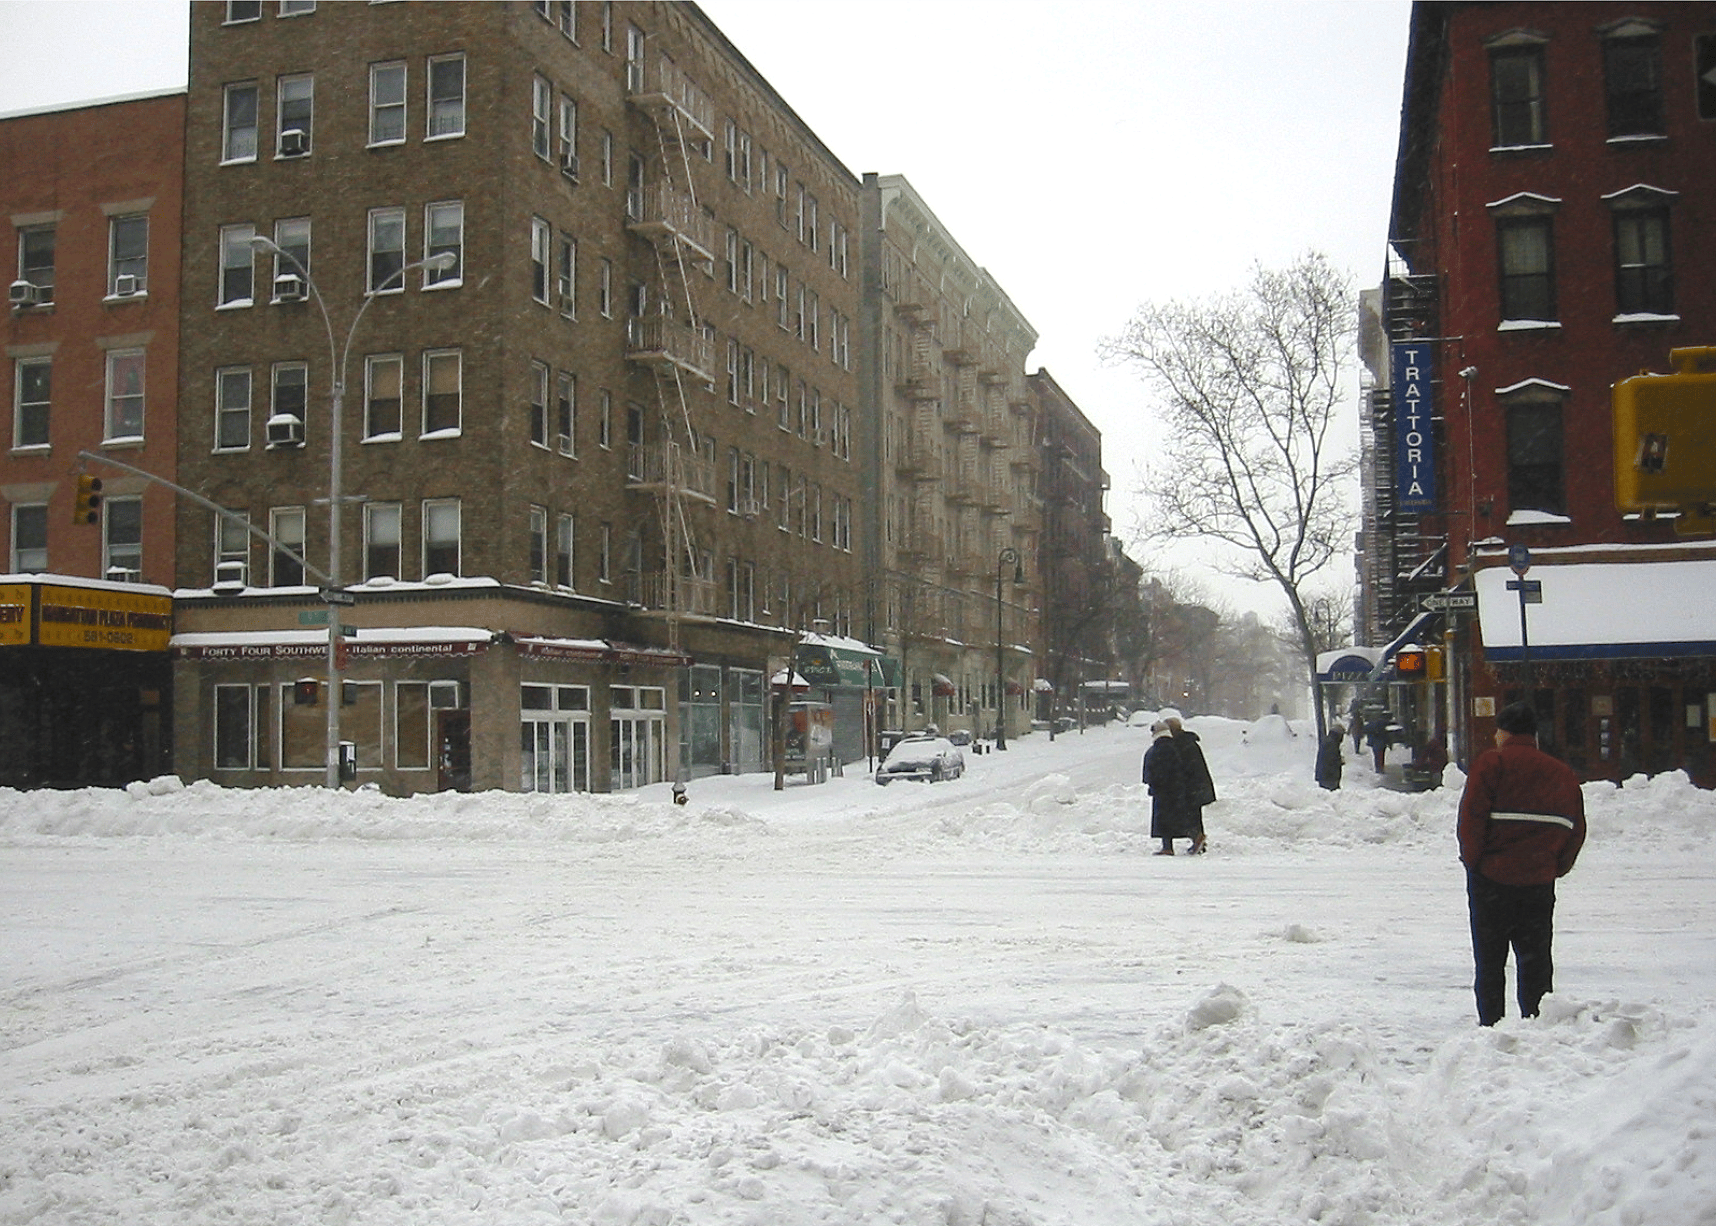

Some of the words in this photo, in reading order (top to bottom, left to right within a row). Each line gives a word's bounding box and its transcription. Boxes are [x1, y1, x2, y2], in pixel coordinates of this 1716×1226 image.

[1404, 350, 1424, 496] TRATTORIA
[1451, 597, 1471, 606] WAY
[275, 645, 329, 655] SOUTHWE
[390, 644, 453, 654] continental
[1332, 670, 1369, 681] PIZZ
